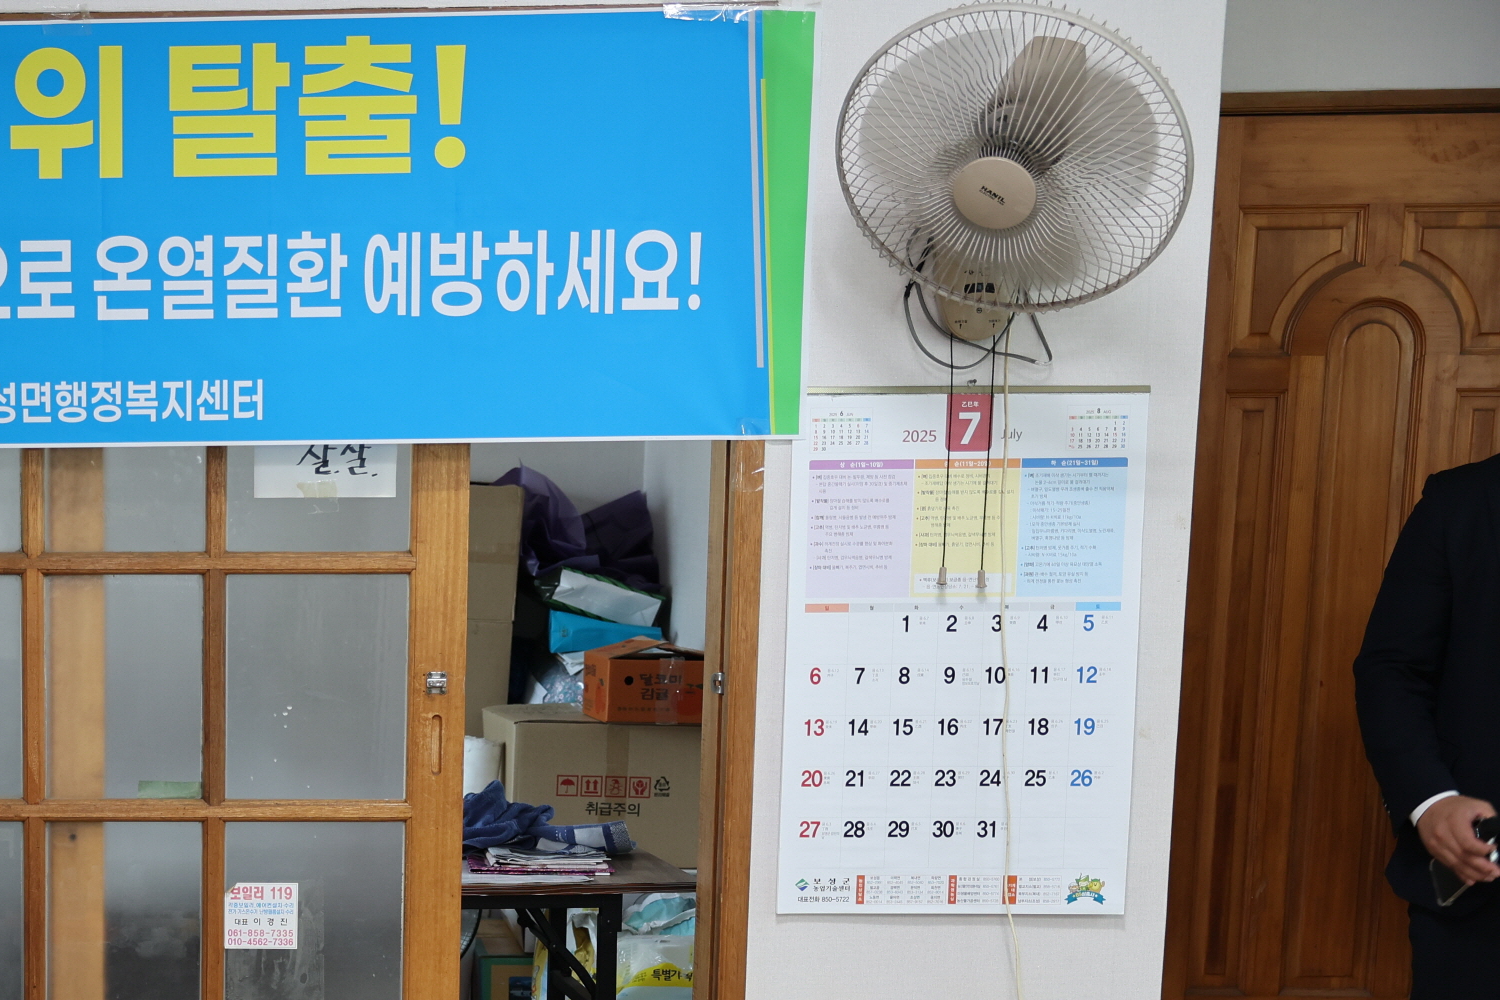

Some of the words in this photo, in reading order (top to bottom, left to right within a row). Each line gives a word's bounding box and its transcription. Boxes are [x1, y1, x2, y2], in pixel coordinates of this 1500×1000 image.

[168, 35, 467, 178] 탈출!
[981, 186, 1005, 204] HANIL
[94, 231, 348, 321] 온열질환
[364, 228, 703, 317] 예방하세요!
[902, 430, 937, 442] 2025
[958, 412, 981, 445] 7
[1001, 428, 1023, 442] July
[903, 615, 908, 632] 1
[947, 615, 957, 632] 2
[992, 615, 1001, 632] 3
[1037, 615, 1048, 631] 4
[1084, 615, 1094, 631] 5
[810, 668, 821, 684] 6
[855, 668, 865, 684] 7
[899, 667, 910, 684] 8
[944, 667, 955, 684] 9
[986, 667, 1005, 684] 10
[1031, 667, 1048, 683] 11
[1077, 666, 1097, 683] 12
[805, 719, 824, 736] 13
[849, 719, 868, 735] 14
[893, 719, 913, 735] 15
[938, 718, 958, 735] 16
[983, 719, 1003, 735] 17
[1029, 718, 1048, 735] 18
[1075, 718, 1095, 735] 19
[801, 770, 822, 787] 20
[846, 770, 863, 787] 21
[890, 770, 911, 786] 22
[935, 770, 956, 787] 23
[980, 770, 1001, 786] 24
[1025, 770, 1046, 786] 25
[1070, 770, 1092, 786] 26
[585, 802, 640, 817] 취급주의
[800, 821, 820, 837] 27
[844, 821, 865, 838] 28
[888, 821, 909, 837] 29
[933, 821, 954, 837] 30
[977, 821, 995, 837] 31
[230, 886, 264, 900] 보일러
[270, 887, 292, 900] 119
